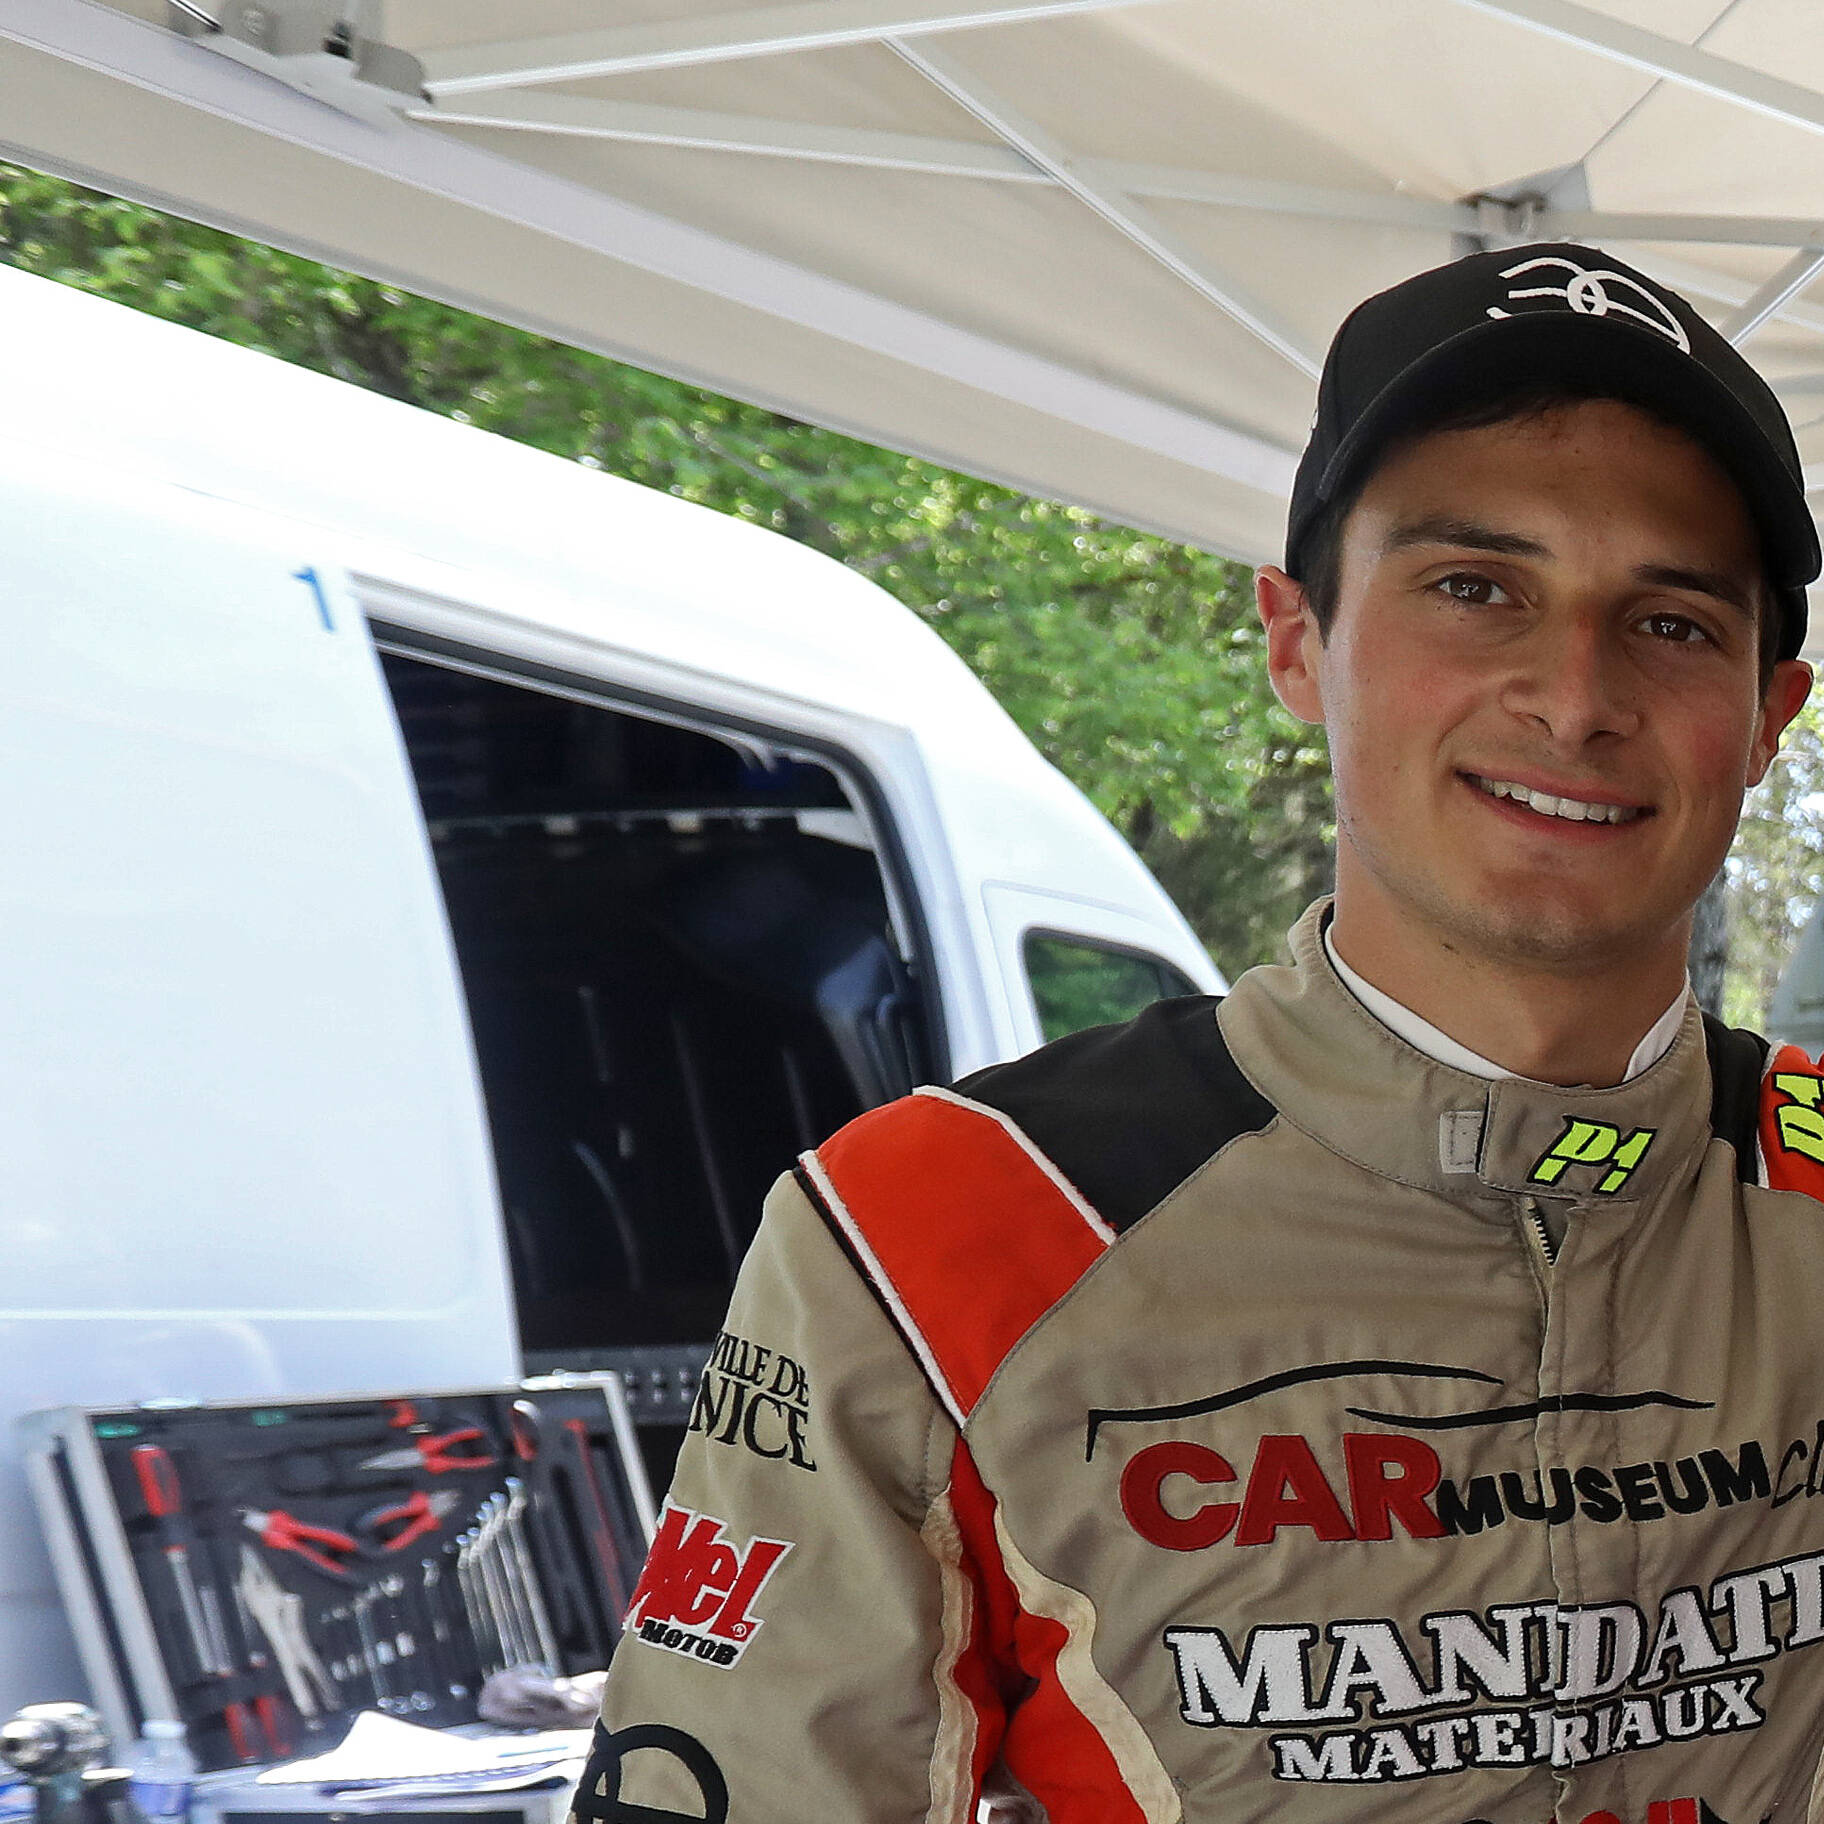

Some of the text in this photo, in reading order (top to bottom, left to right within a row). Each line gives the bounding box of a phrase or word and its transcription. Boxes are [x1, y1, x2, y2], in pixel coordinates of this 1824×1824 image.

[1527, 1114, 1658, 1195] P1
[689, 1370, 818, 1472] NICE
[1274, 1674, 1762, 1783] MATERIAUX
